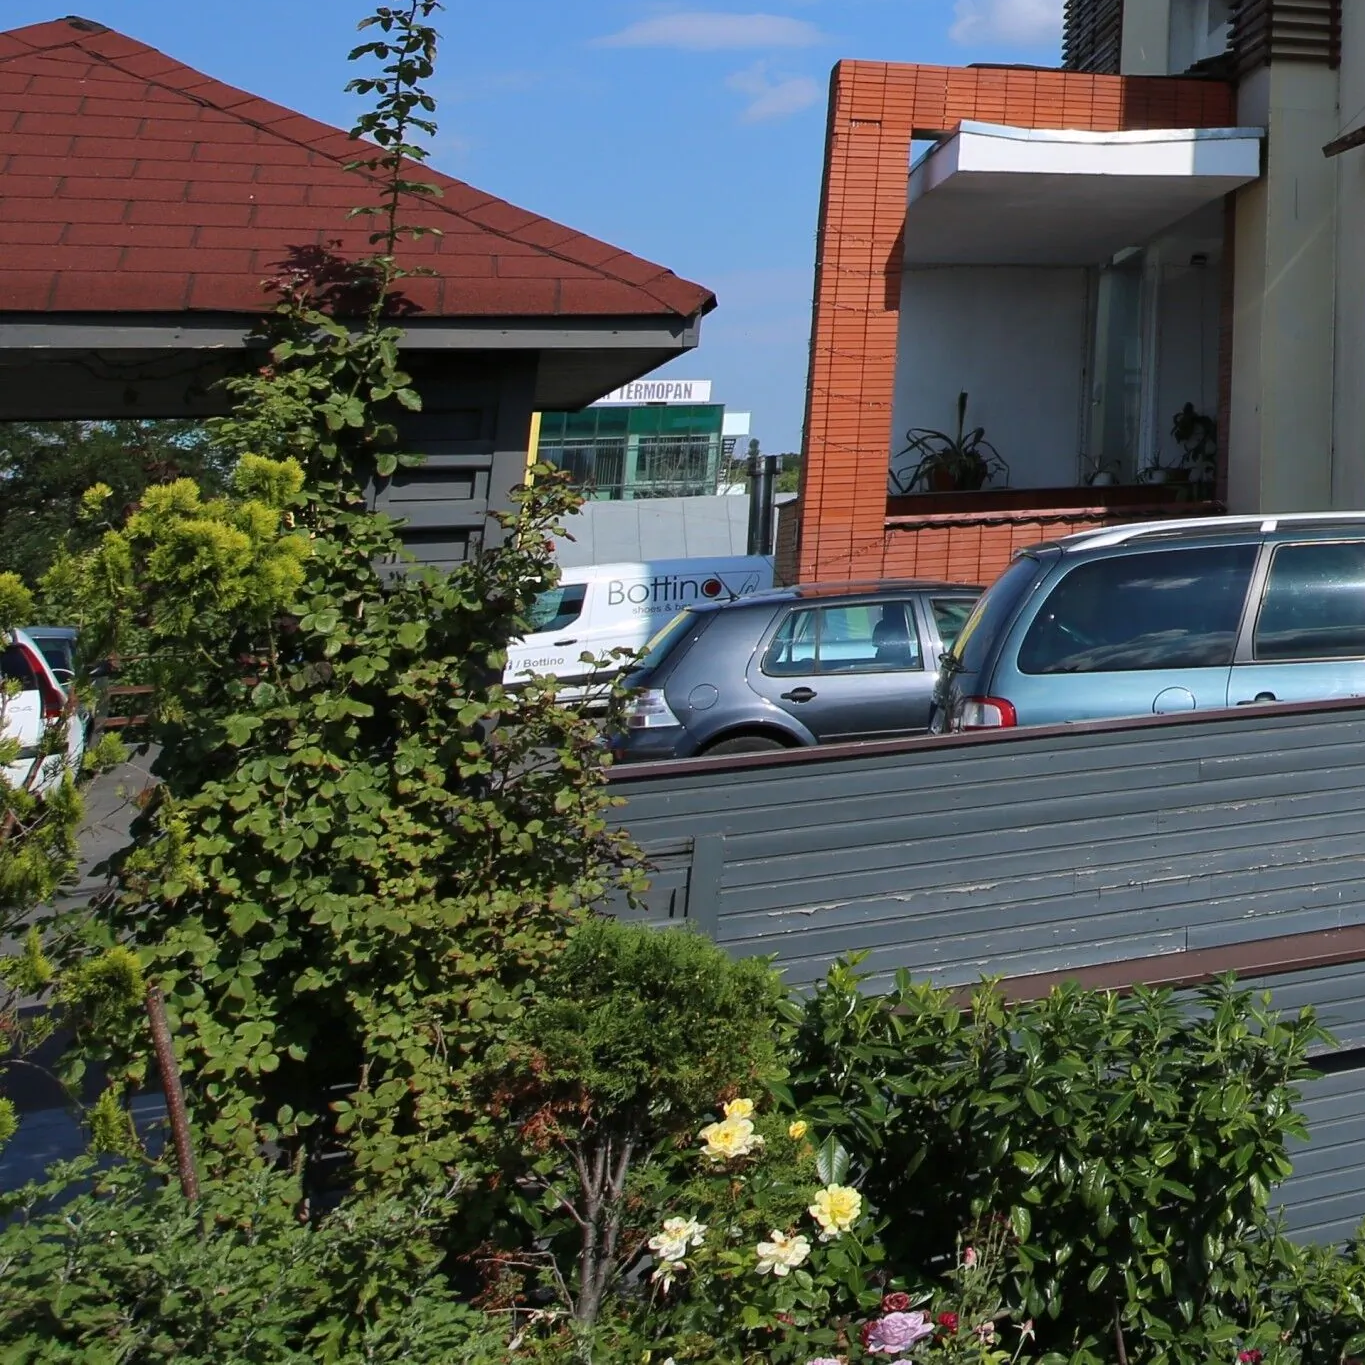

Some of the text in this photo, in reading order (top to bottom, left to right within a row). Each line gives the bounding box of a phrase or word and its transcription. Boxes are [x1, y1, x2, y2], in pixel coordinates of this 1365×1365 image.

[619, 383, 693, 400] TERMOPAN
[608, 576, 723, 605] Bottino
[632, 605, 662, 614] shoes
[523, 657, 564, 668] Bottino
